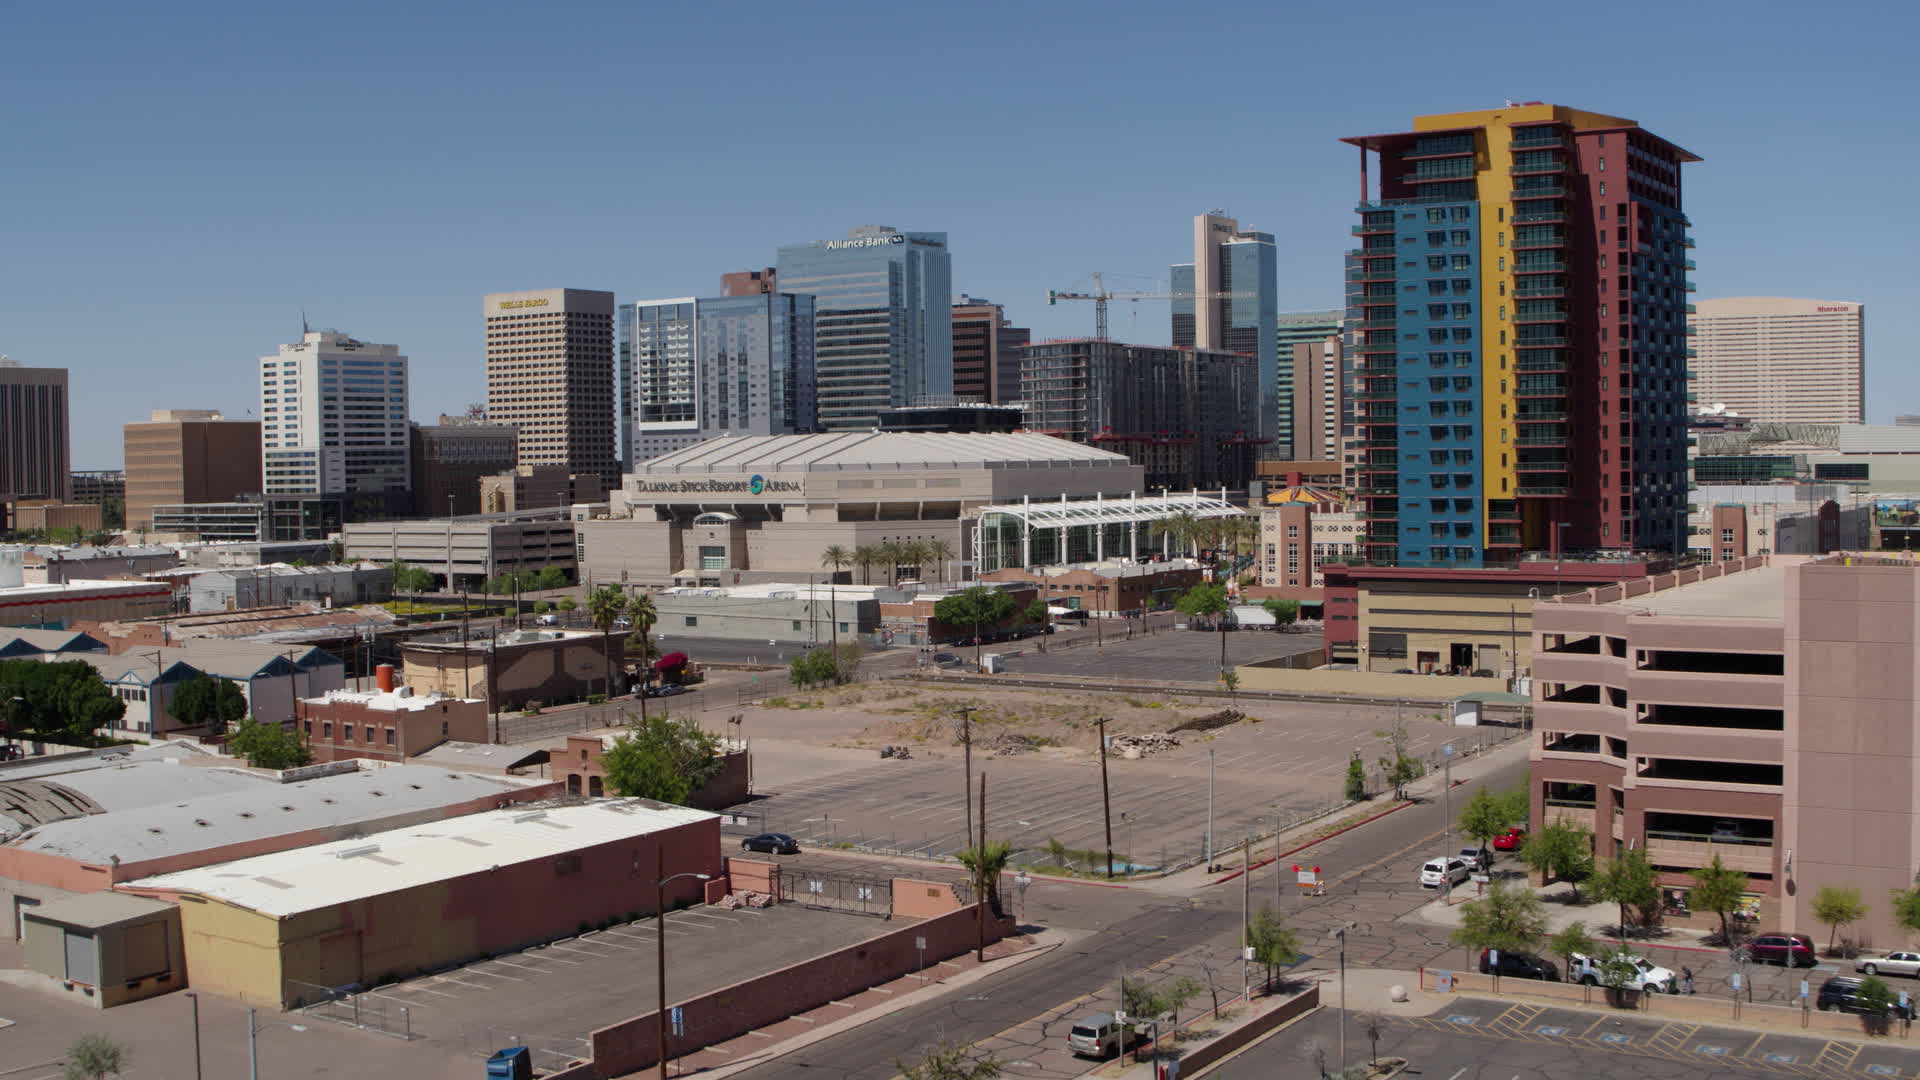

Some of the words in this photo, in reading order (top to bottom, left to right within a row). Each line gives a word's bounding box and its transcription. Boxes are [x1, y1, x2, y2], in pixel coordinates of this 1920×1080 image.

[827, 239, 864, 250] Alliance
[866, 236, 890, 247] Bank
[636, 480, 677, 493] TALKING
[680, 479, 706, 492] STICK
[708, 479, 747, 492] RESORT
[764, 479, 802, 492] ARENA
